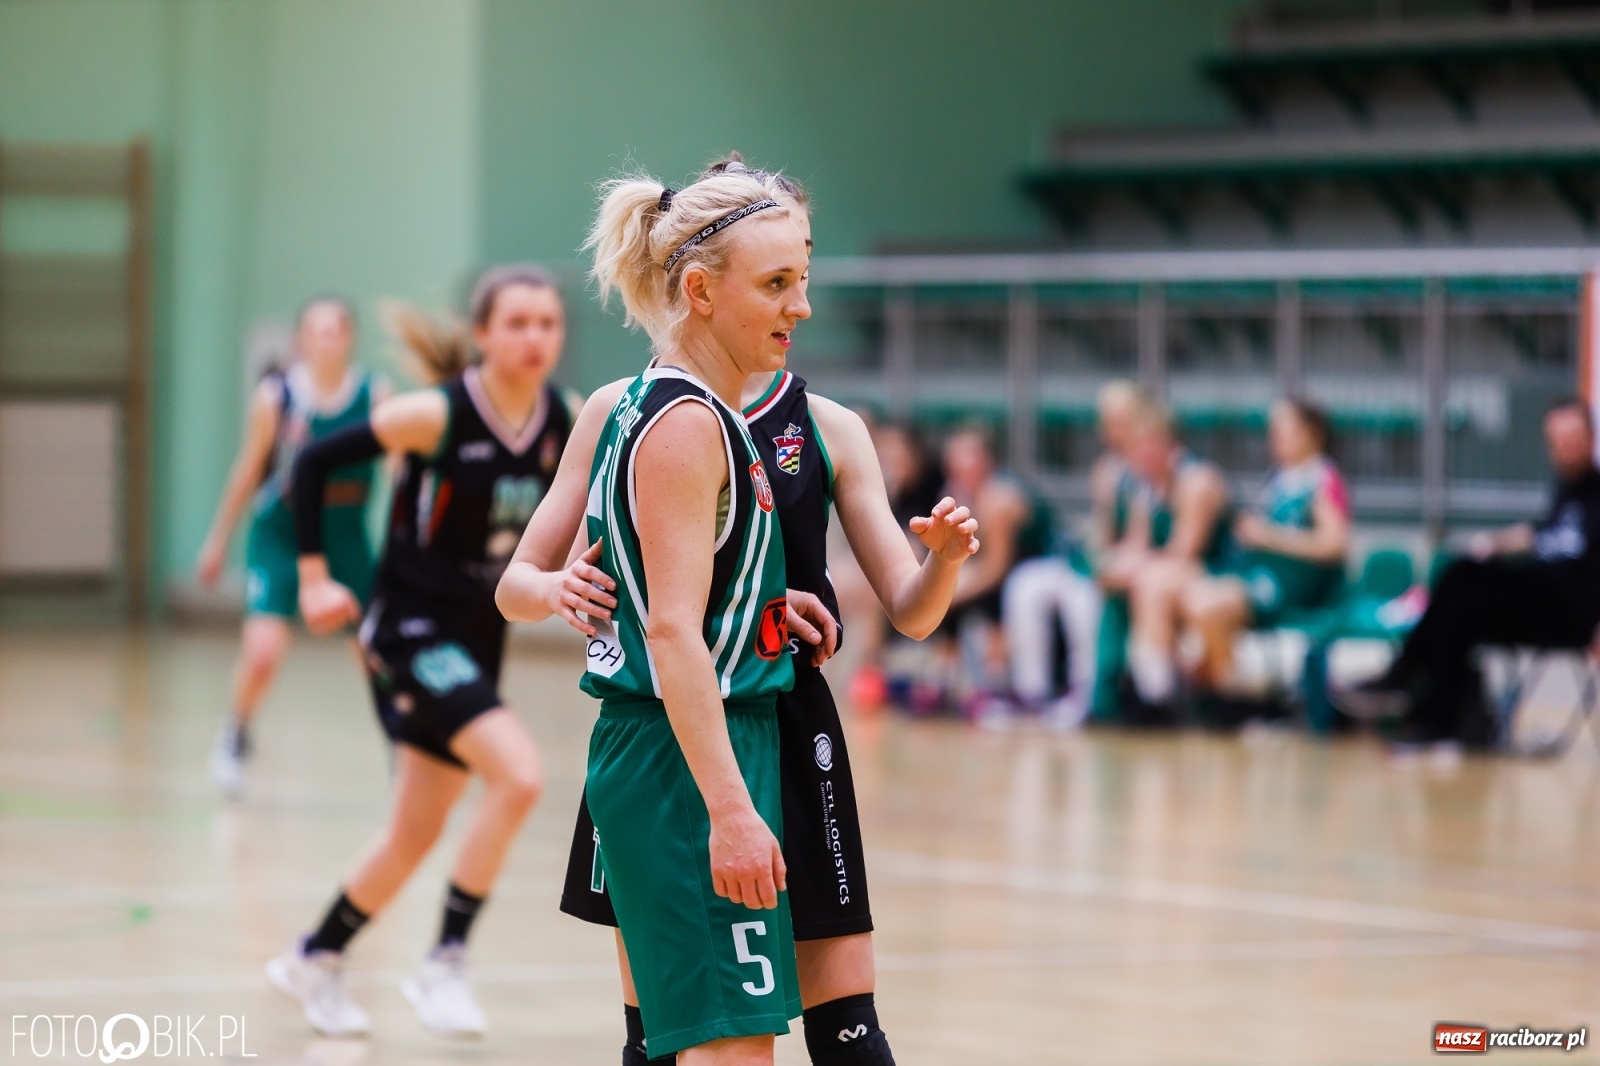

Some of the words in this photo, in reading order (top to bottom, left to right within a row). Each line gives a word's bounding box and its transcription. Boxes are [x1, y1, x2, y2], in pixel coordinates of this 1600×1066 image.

[820, 782, 829, 823] Connecting
[826, 780, 834, 813] CTL
[824, 823, 832, 850] Europe
[829, 818, 850, 905] LOGISTICS
[731, 921, 775, 996] 5
